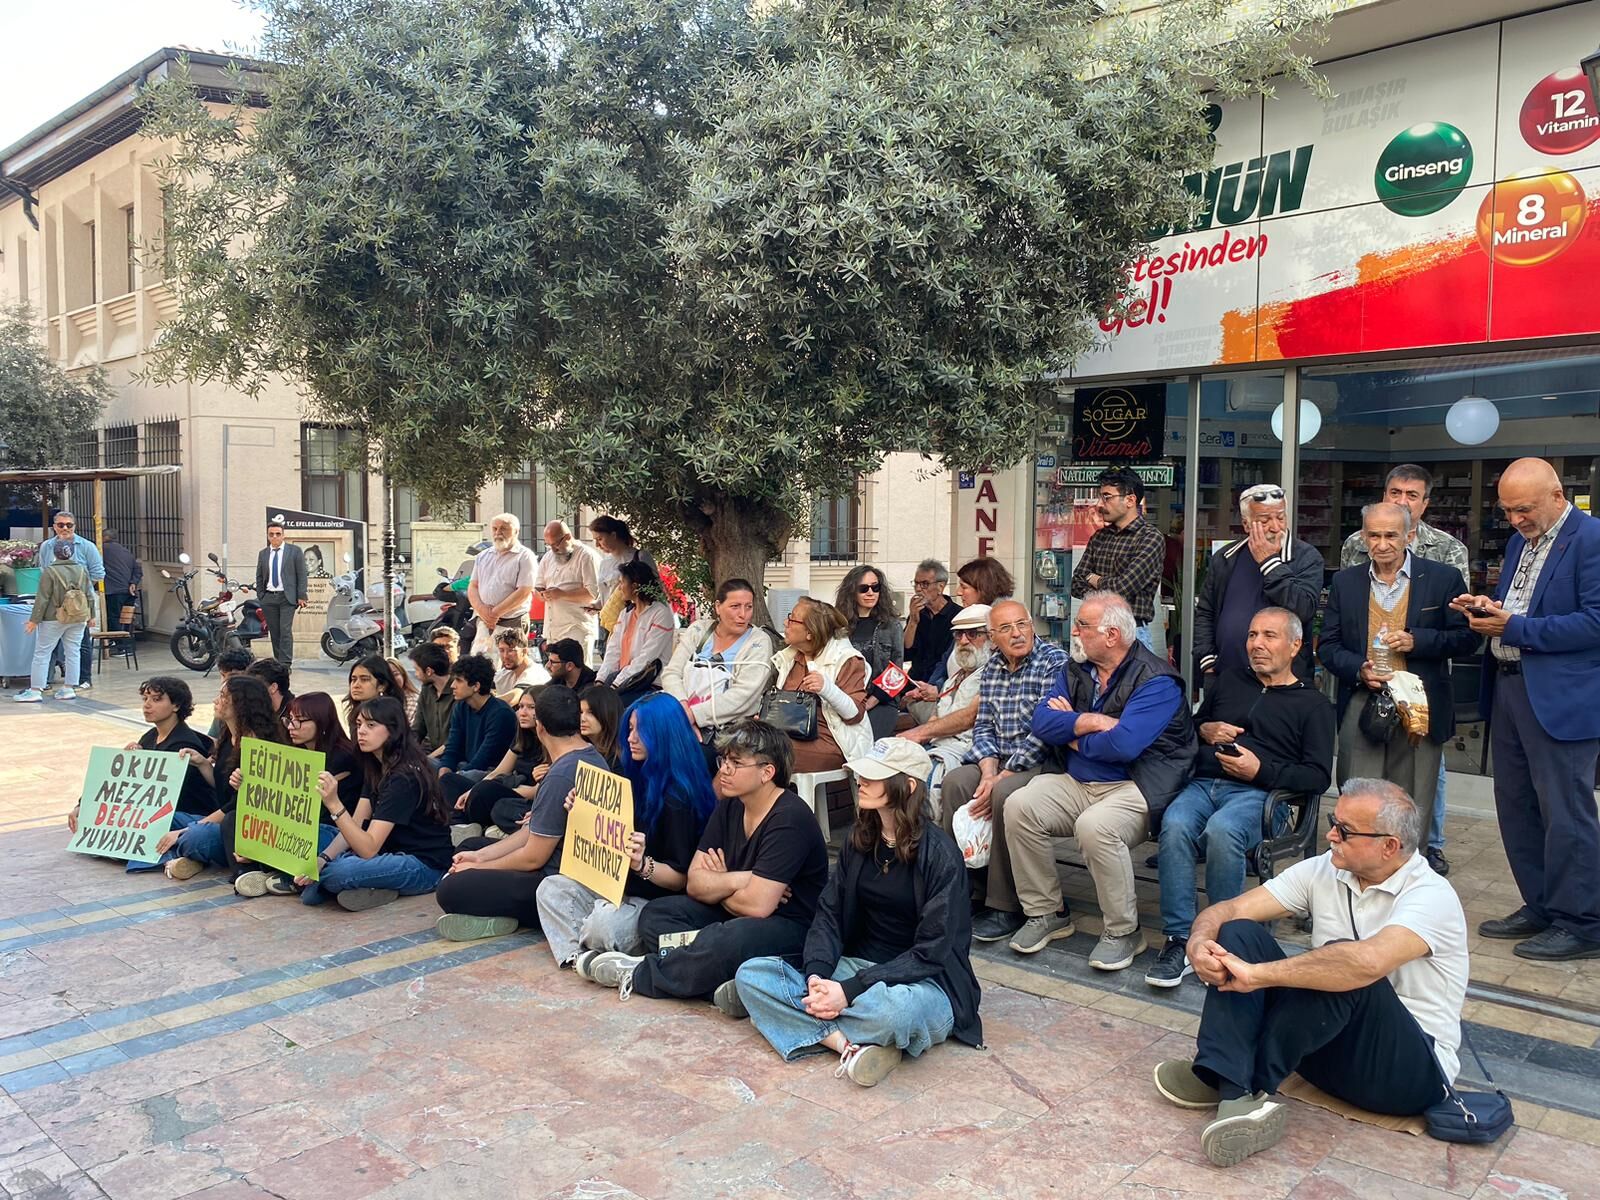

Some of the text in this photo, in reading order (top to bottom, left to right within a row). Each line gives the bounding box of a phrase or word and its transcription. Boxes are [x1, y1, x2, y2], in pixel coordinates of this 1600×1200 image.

[1551, 89, 1586, 119] 12
[1536, 114, 1599, 136] Vitamin
[1384, 156, 1463, 183] Ginseng
[1516, 194, 1545, 226] 8
[1494, 221, 1568, 247] Mineral
[1082, 407, 1147, 422] SOLGAR
[1074, 433, 1153, 457] Vitamin
[1199, 431, 1235, 446] CeraVe
[111, 753, 169, 782] OKUL
[249, 745, 311, 793] EĞİTİMDE
[94, 780, 169, 808] MEZAR
[246, 783, 313, 826] KORKU DEĞİL
[575, 766, 623, 816] OKULLARDA
[75, 826, 146, 856] YUVADIR
[242, 812, 279, 849] GÜVEN
[594, 809, 627, 853] ÖLMEK
[573, 829, 623, 882] İSTEMİYORUZ
